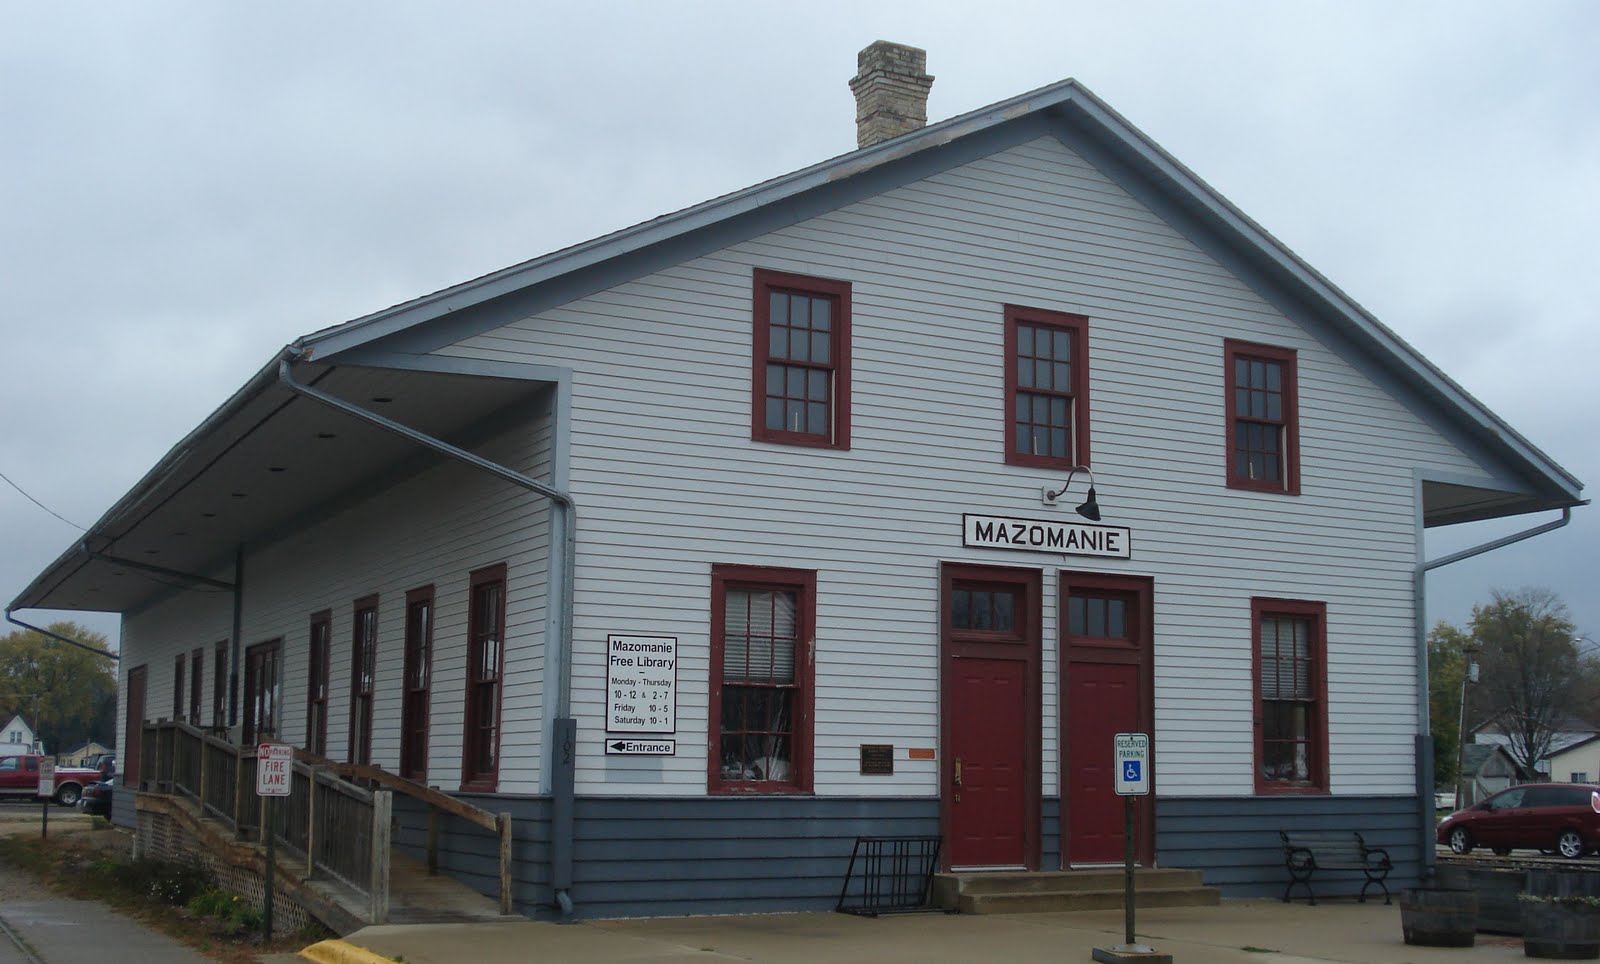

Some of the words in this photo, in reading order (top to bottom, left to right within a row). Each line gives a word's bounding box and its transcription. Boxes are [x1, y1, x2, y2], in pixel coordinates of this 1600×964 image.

[975, 520, 1120, 552] MAZOMANIE
[612, 640, 672, 653] Mazomanie
[610, 655, 634, 667] Free
[637, 656, 674, 671] Library
[611, 677, 637, 687] Monday
[642, 678, 672, 688] Thursday
[614, 703, 636, 713] Friday
[614, 715, 646, 726] Saturday
[626, 742, 671, 752] Entrance
[1117, 740, 1147, 748] RESERVED
[260, 747, 270, 757] NO
[1119, 750, 1145, 758] PARKING
[265, 761, 285, 773] FIRE
[263, 774, 286, 786] LANE
